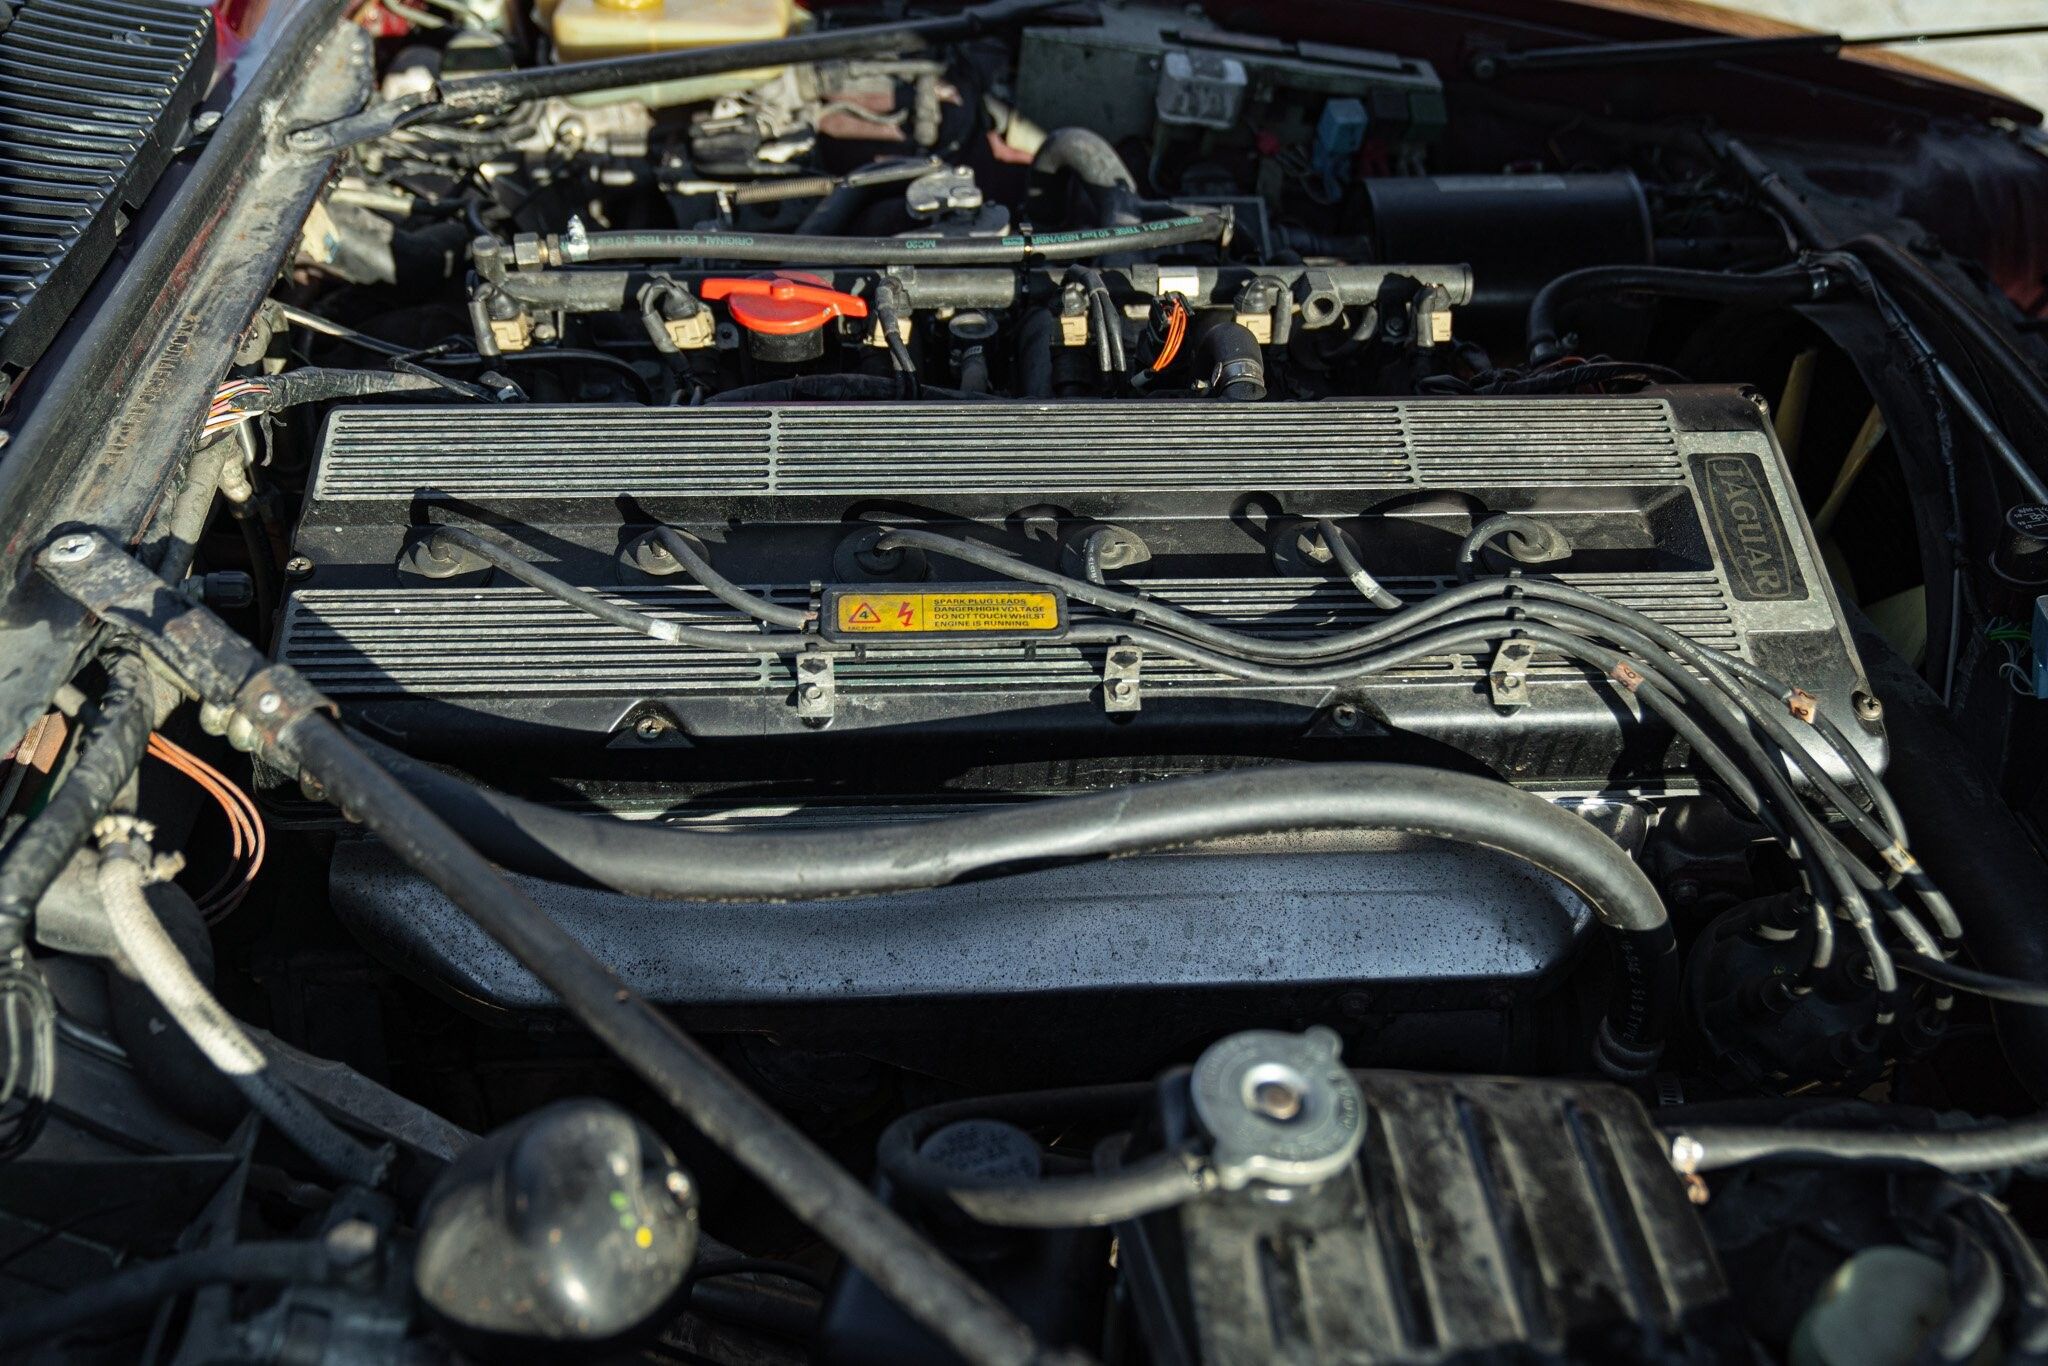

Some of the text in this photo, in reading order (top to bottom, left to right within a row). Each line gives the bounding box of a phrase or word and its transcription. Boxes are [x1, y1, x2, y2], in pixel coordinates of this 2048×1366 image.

[1099, 230, 1109, 239] 10
[675, 235, 698, 245] ECO
[703, 235, 754, 246] ORIGINAL
[1712, 459, 1782, 595] JAGUAR
